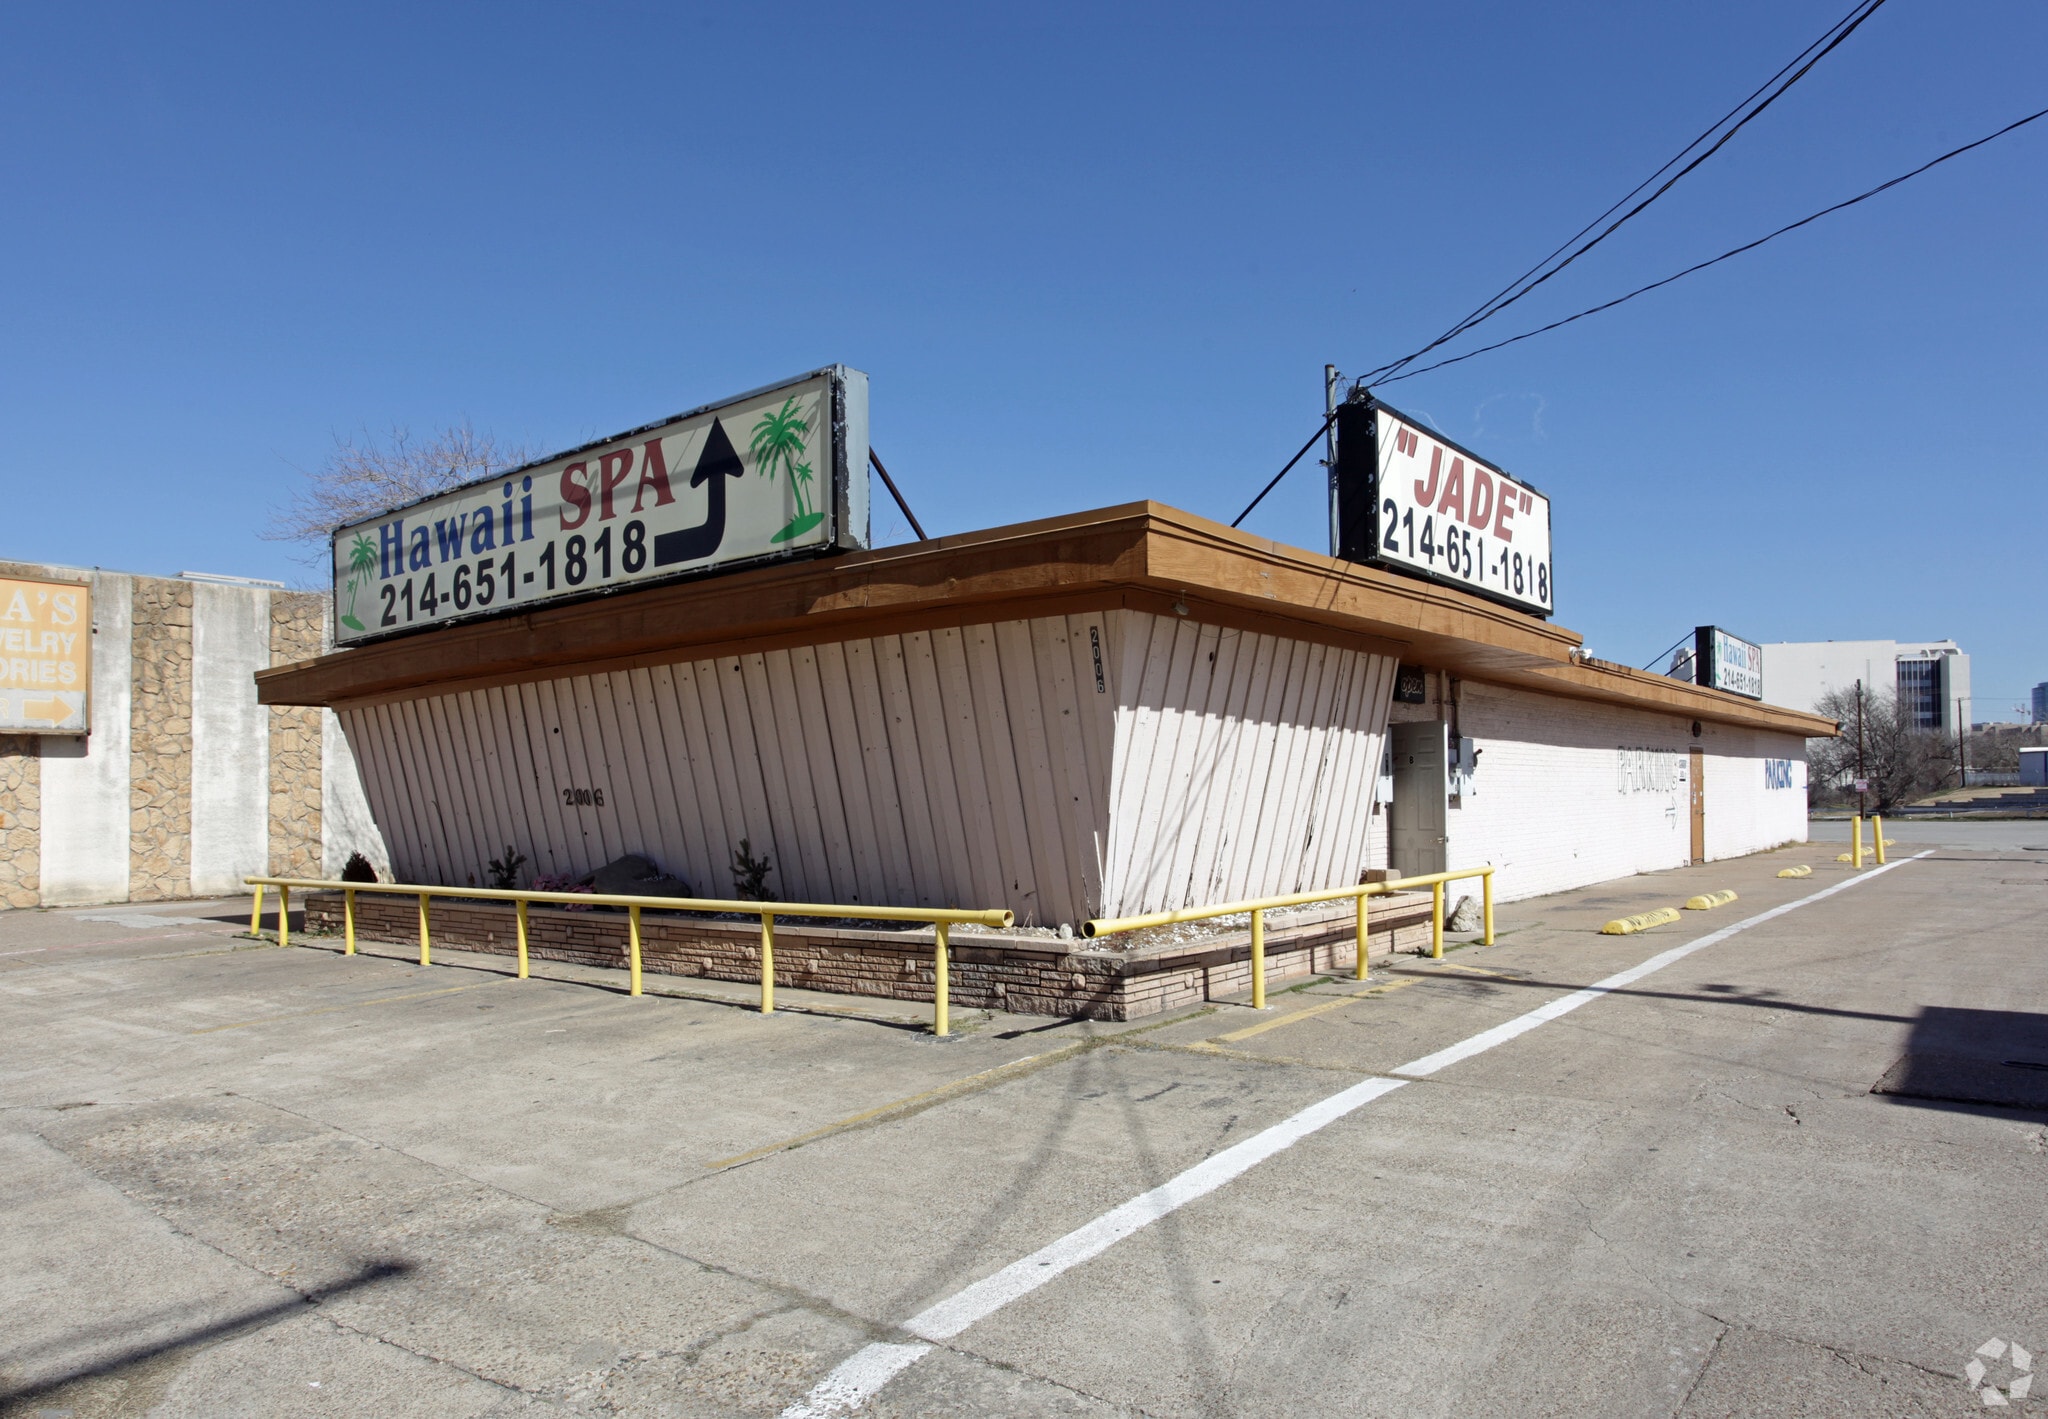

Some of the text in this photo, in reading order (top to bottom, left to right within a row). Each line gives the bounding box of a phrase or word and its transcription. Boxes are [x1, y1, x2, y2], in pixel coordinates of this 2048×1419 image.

[379, 436, 676, 580] Hawaii SPA
[1397, 427, 1533, 543] "JADE"
[380, 520, 647, 627] 214-651-1818
[1382, 498, 1548, 604] 214-651-1818
[0, 628, 77, 655] ELRY
[1091, 629, 1104, 693] 2006
[1723, 635, 1760, 674] Hawaii SPA
[563, 788, 605, 807] 2006
[1618, 745, 1677, 795] PARKING
